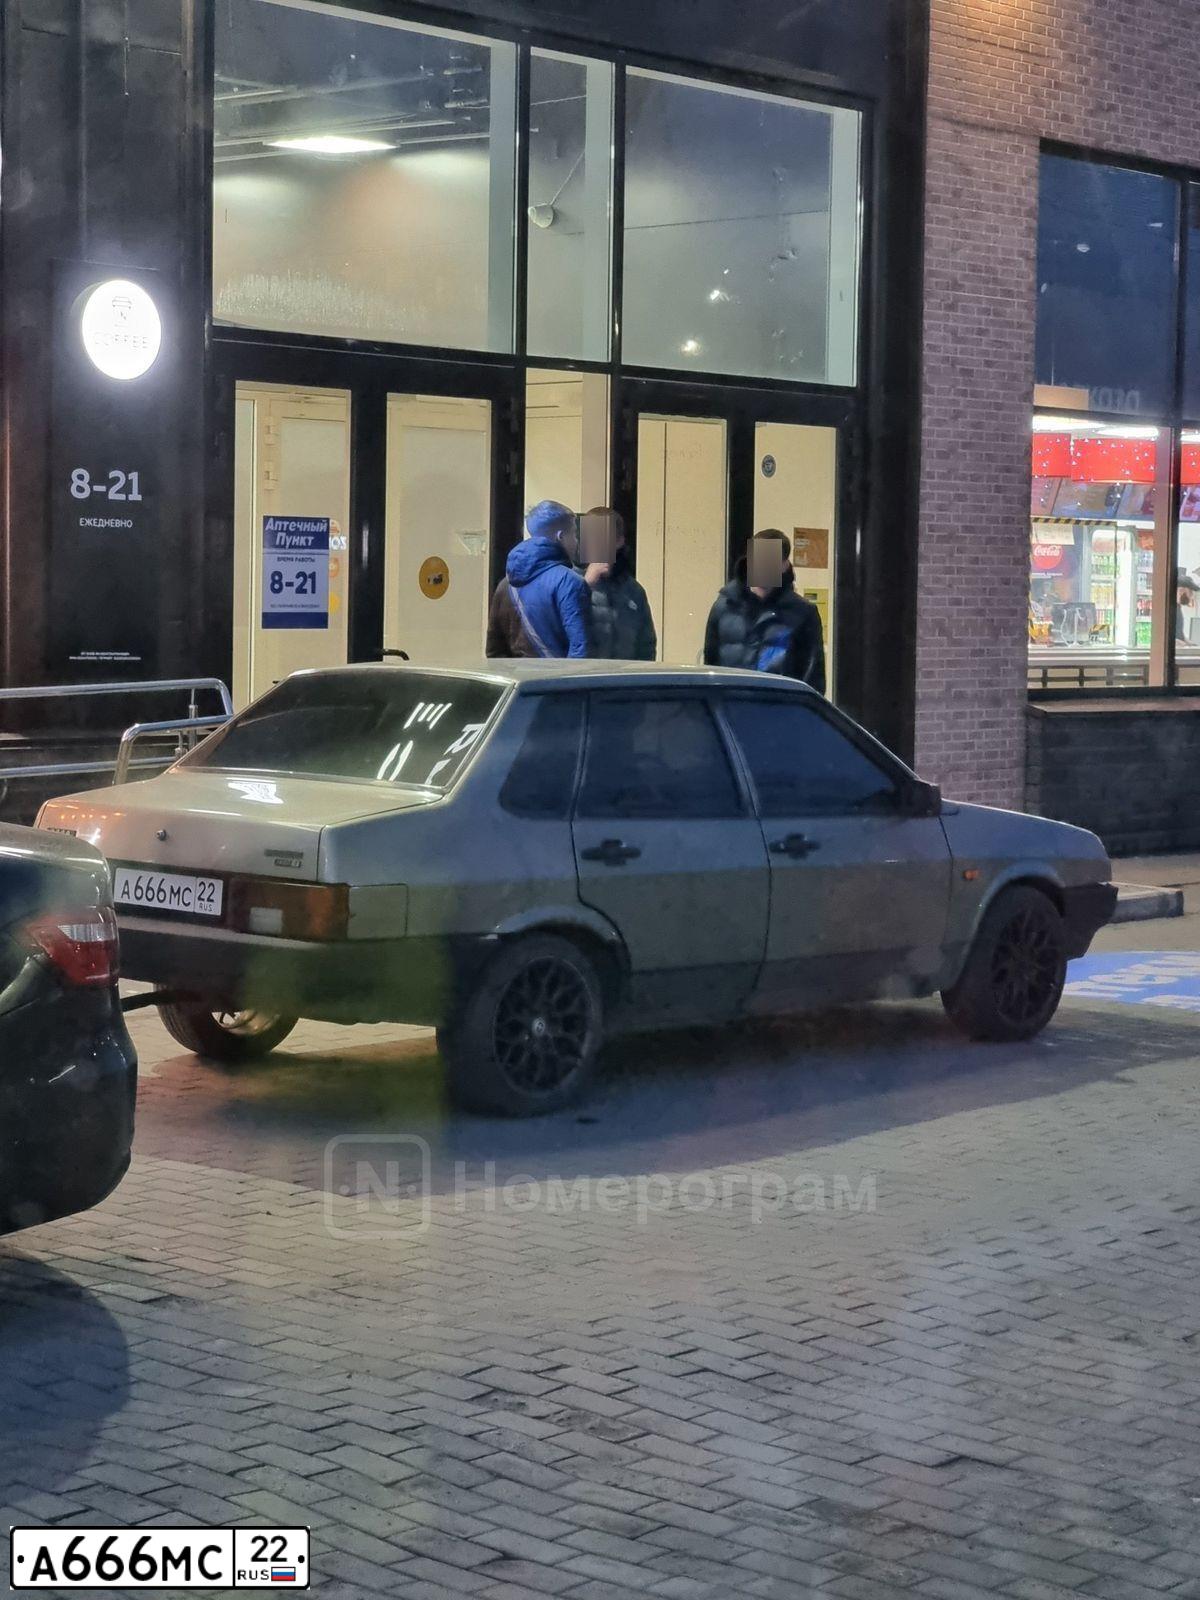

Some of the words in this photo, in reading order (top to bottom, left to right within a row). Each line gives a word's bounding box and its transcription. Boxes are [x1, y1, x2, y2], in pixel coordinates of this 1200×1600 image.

[70, 468, 143, 501] 8-21
[79, 517, 133, 529] ЕЖЕДНЕВНО
[265, 518, 328, 532] Аптечный
[275, 532, 315, 549] Пункт
[270, 570, 316, 594] 8-21
[198, 881, 215, 903] 22
[199, 903, 213, 912] RUS
